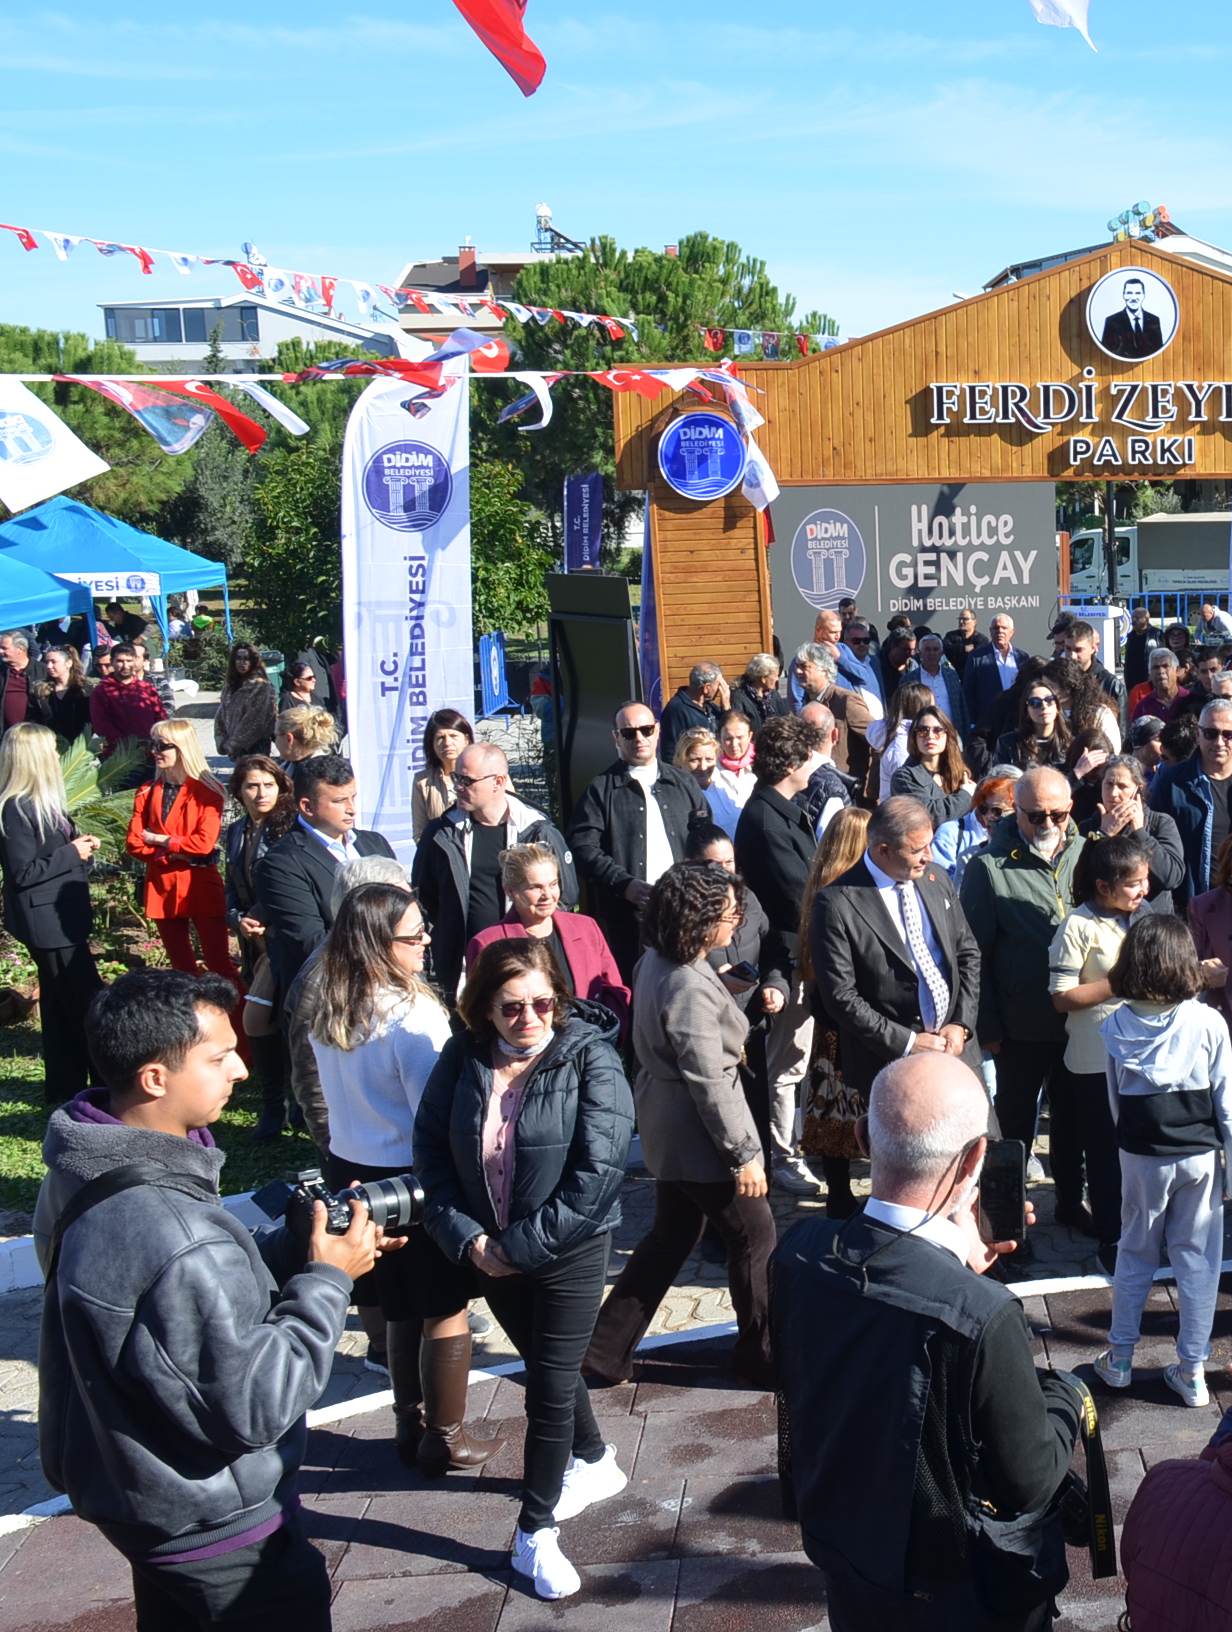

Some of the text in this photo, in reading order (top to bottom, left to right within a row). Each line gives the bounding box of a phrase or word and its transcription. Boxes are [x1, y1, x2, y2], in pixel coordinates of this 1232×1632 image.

[930, 366, 1099, 433] FERDİ
[679, 425, 724, 440] DİDİM
[680, 439, 724, 447] BELEDİYESİ
[382, 451, 433, 467] DİDİM
[1070, 436, 1196, 466] PARKI
[384, 467, 434, 477] BELEDİYESİ
[581, 484, 590, 534] BELEDİYESİ
[911, 504, 1014, 547] Hatice
[806, 520, 848, 539] DİDİM
[807, 538, 849, 549] BELEDİYESİ
[889, 550, 1038, 593] GENÇAY
[889, 595, 1040, 612] DİDİM BELEDİYE BAŞKANI
[380, 651, 399, 697] T.C.
[404, 555, 428, 771] İDİM BELEDİYESİ
[1083, 1396, 1096, 1439] Nikon
[1095, 1514, 1107, 1552] Nikon
